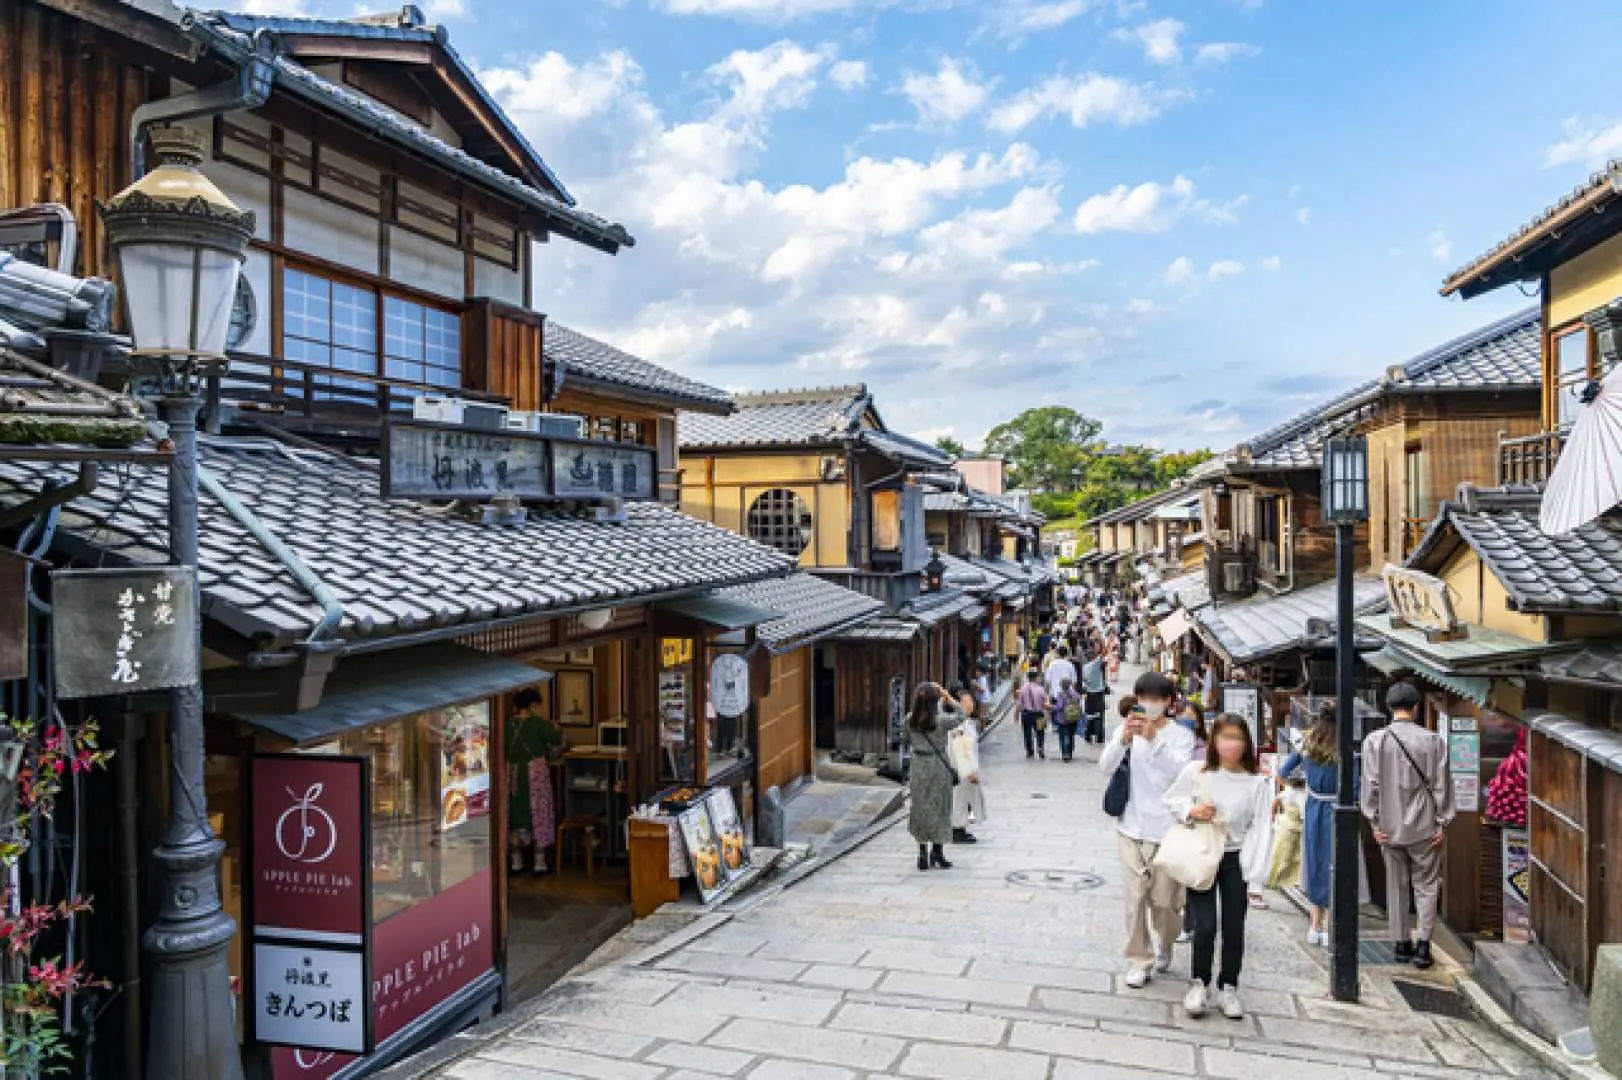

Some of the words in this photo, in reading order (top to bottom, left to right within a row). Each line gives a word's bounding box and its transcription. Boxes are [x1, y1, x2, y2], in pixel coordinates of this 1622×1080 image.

[262, 868, 300, 885] APPLE
[305, 870, 326, 886] PIE
[331, 873, 353, 888] lab
[372, 959, 416, 1003] PPLE
[422, 938, 450, 972] PIE
[455, 922, 480, 951] lab
[265, 989, 353, 1024] きんつば
